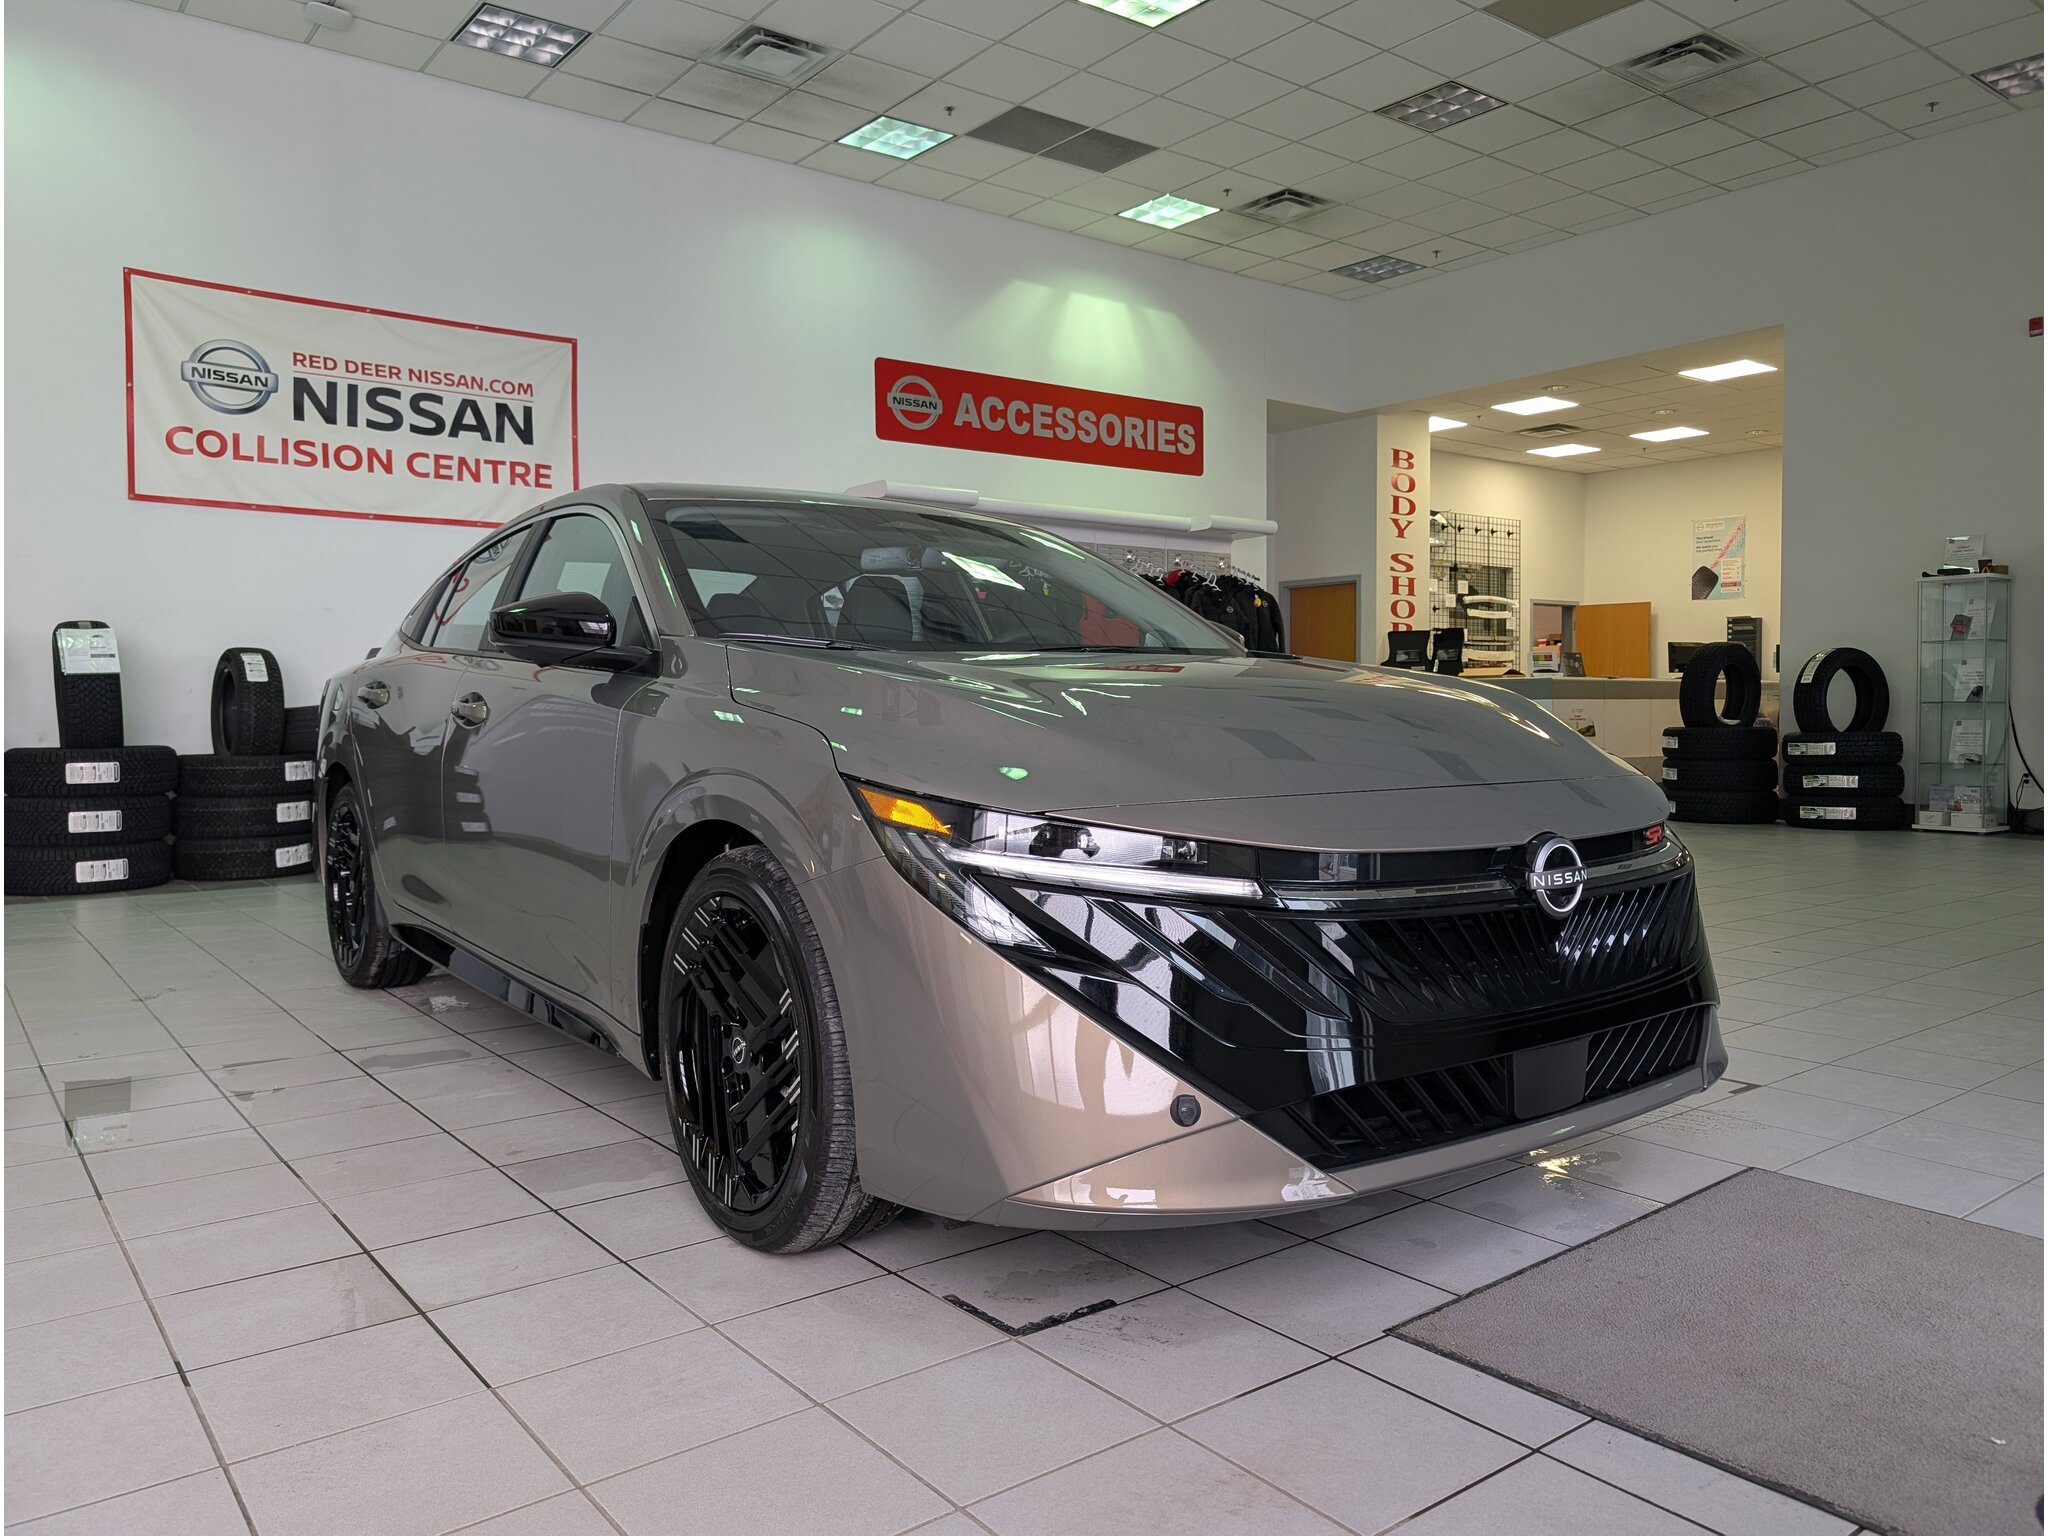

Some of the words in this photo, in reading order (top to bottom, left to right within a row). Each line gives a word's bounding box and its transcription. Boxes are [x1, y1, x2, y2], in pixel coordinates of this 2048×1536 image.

[191, 366, 269, 388] NISSAN
[292, 351, 338, 371] RED
[344, 358, 403, 381] DEER
[408, 368, 534, 398] NISSAN.COM
[292, 376, 534, 446] NISSAN
[892, 396, 938, 410] NISSAN
[953, 392, 1197, 456] ACCESSORIES
[164, 425, 394, 475] COLLISION
[406, 451, 553, 490] CENTRE
[1389, 447, 1417, 540] BODY
[1533, 868, 1588, 888] NISSAN
